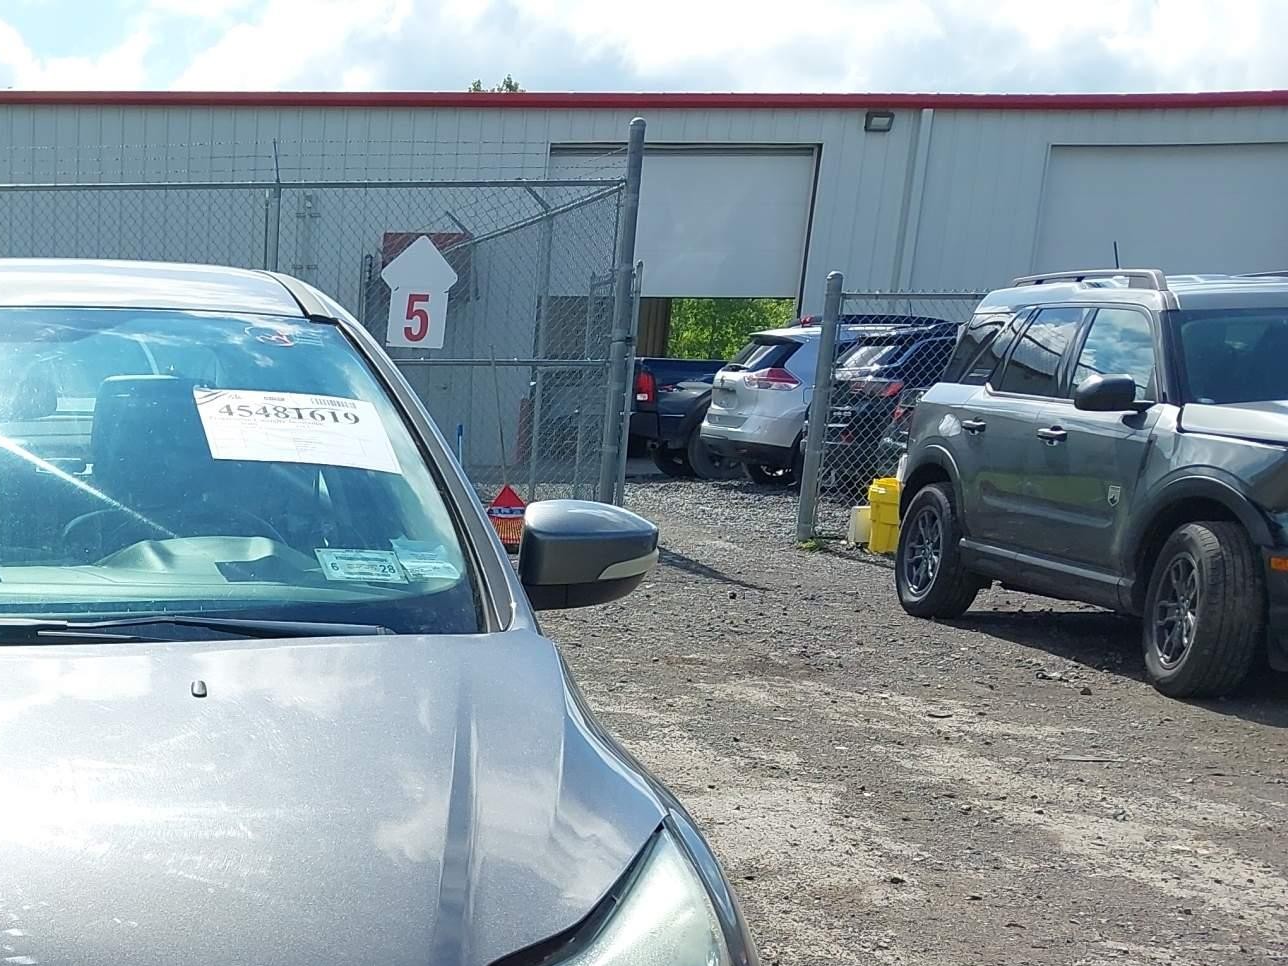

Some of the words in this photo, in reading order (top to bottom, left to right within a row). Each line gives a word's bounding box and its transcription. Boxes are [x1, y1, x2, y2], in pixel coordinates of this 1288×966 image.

[403, 293, 430, 342] 5
[218, 403, 361, 426] 45481619
[379, 564, 396, 574] 28
